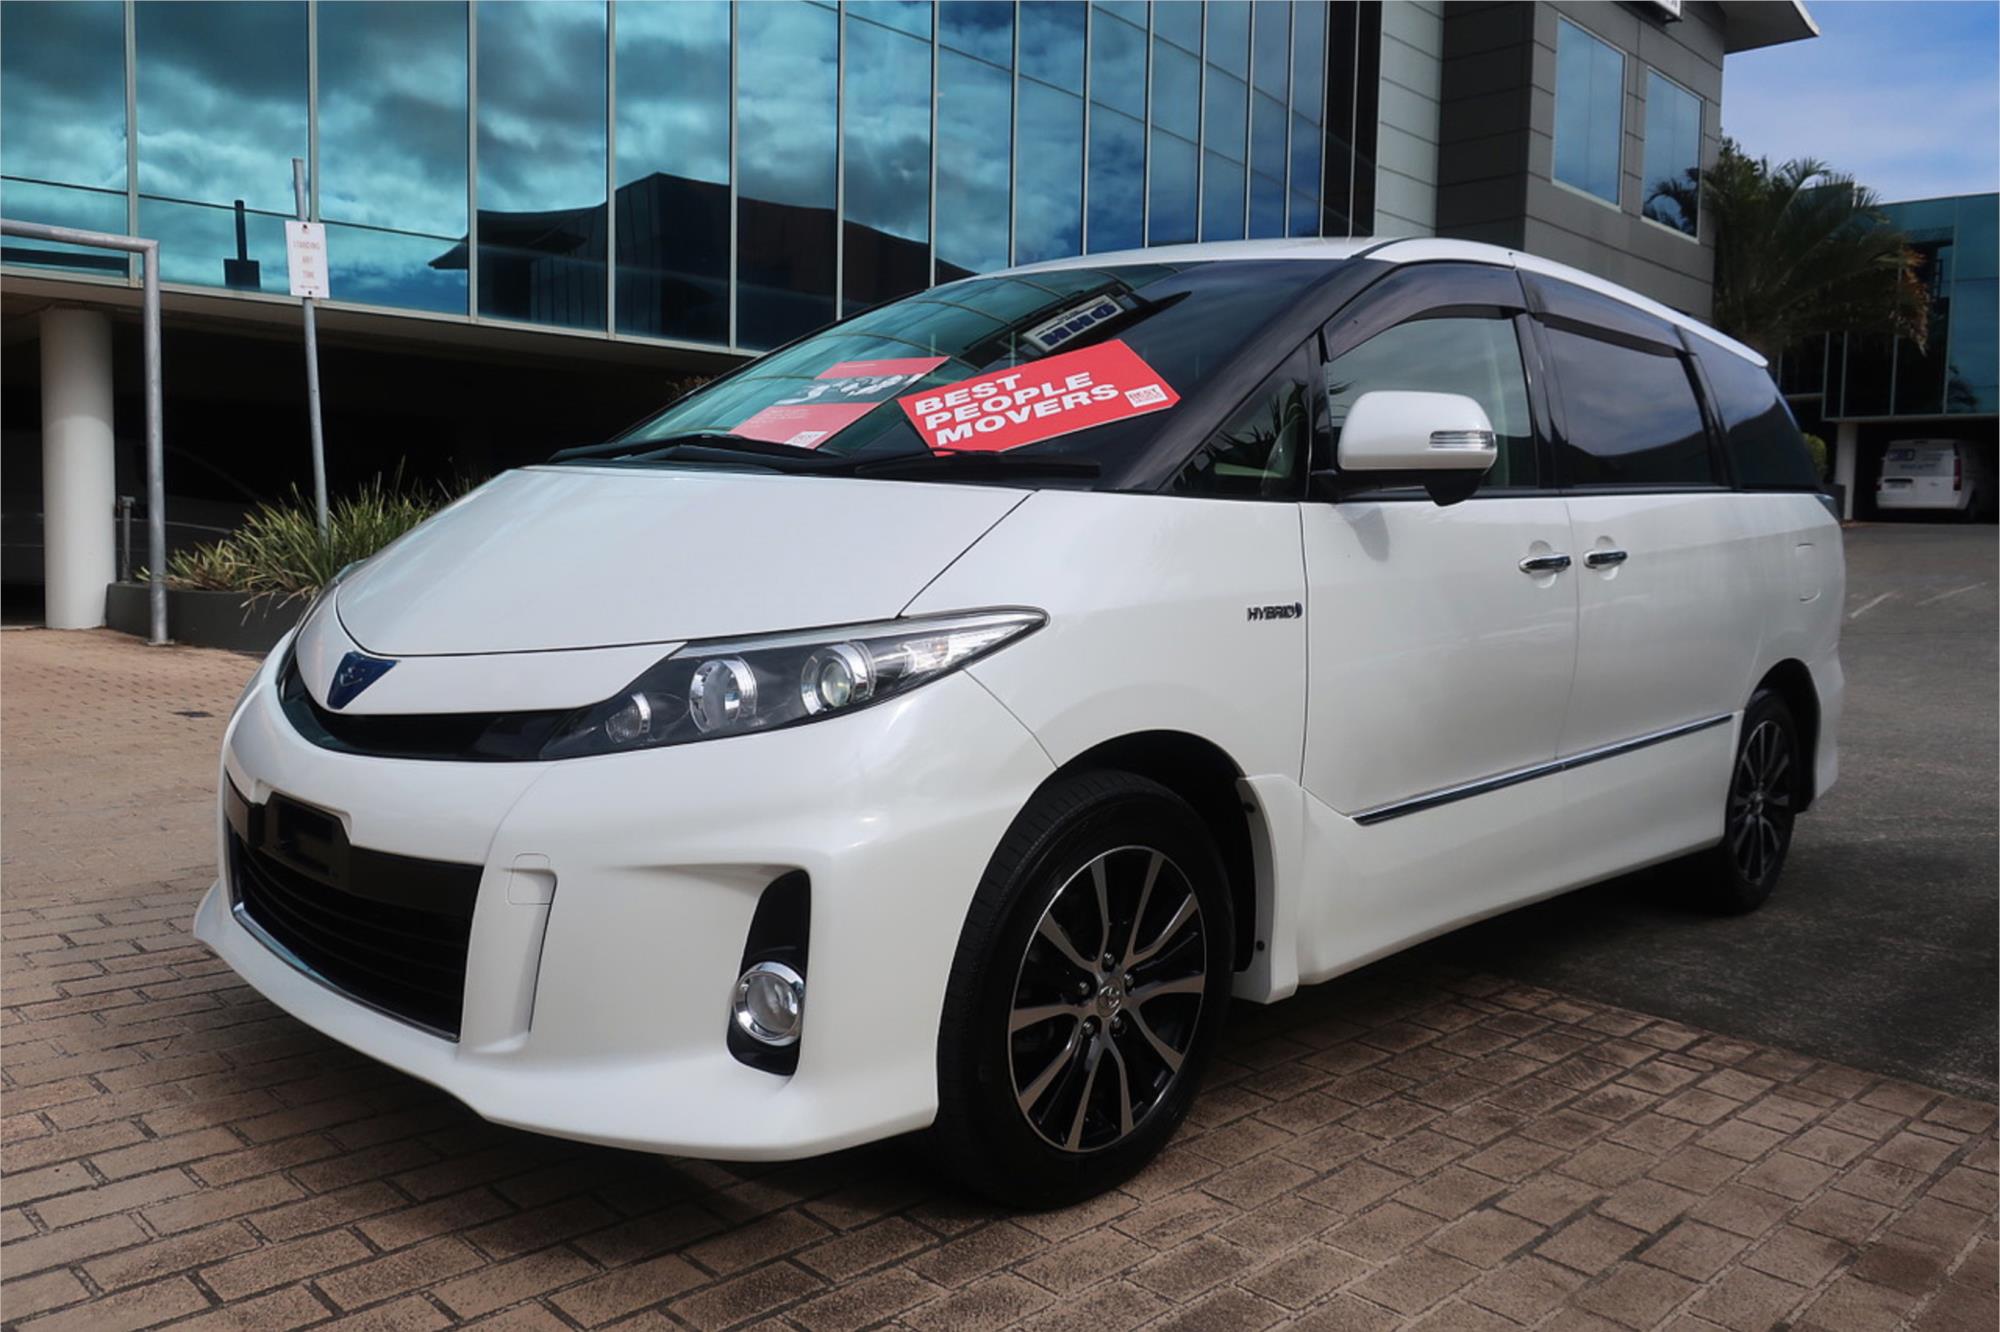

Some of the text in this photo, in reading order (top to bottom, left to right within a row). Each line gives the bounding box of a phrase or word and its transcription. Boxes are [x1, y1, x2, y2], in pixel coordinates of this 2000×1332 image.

[915, 374, 1021, 416] BEST
[925, 372, 1094, 430] PEOPLE
[936, 384, 1119, 446] MOVERS
[1247, 605, 1296, 621] HYBRID
